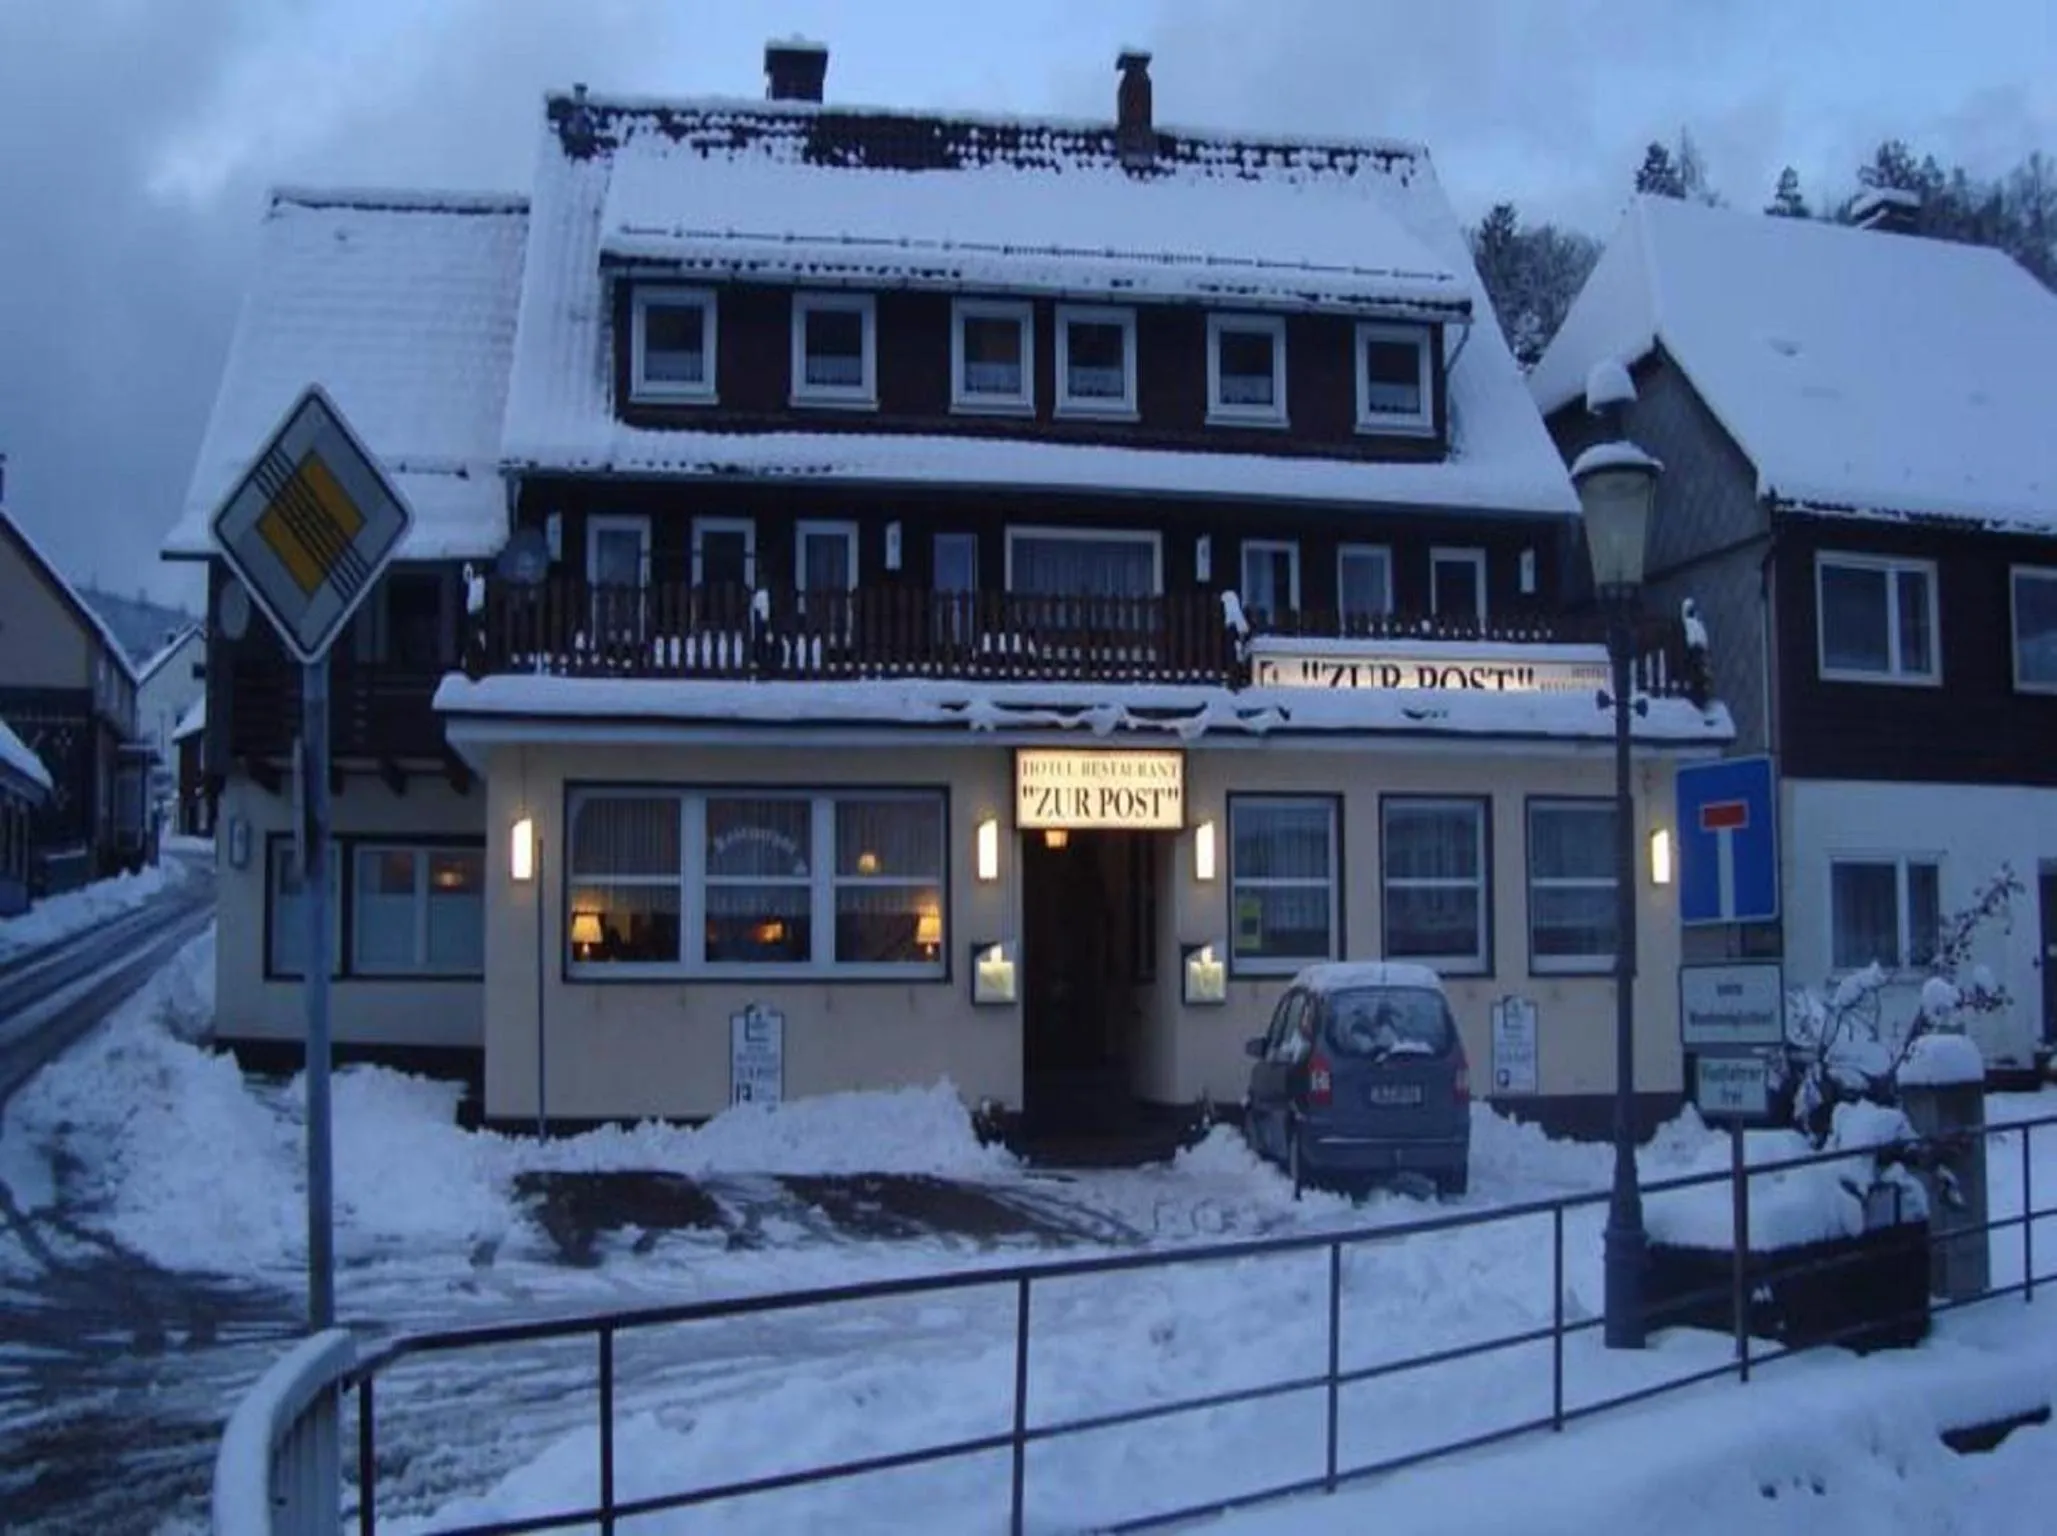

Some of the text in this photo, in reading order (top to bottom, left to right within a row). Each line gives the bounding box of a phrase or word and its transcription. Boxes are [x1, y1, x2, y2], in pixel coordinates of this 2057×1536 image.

[1022, 759, 1178, 778] HOTEL RESTAURANT
[1023, 785, 1179, 819] "ZUR POST"
